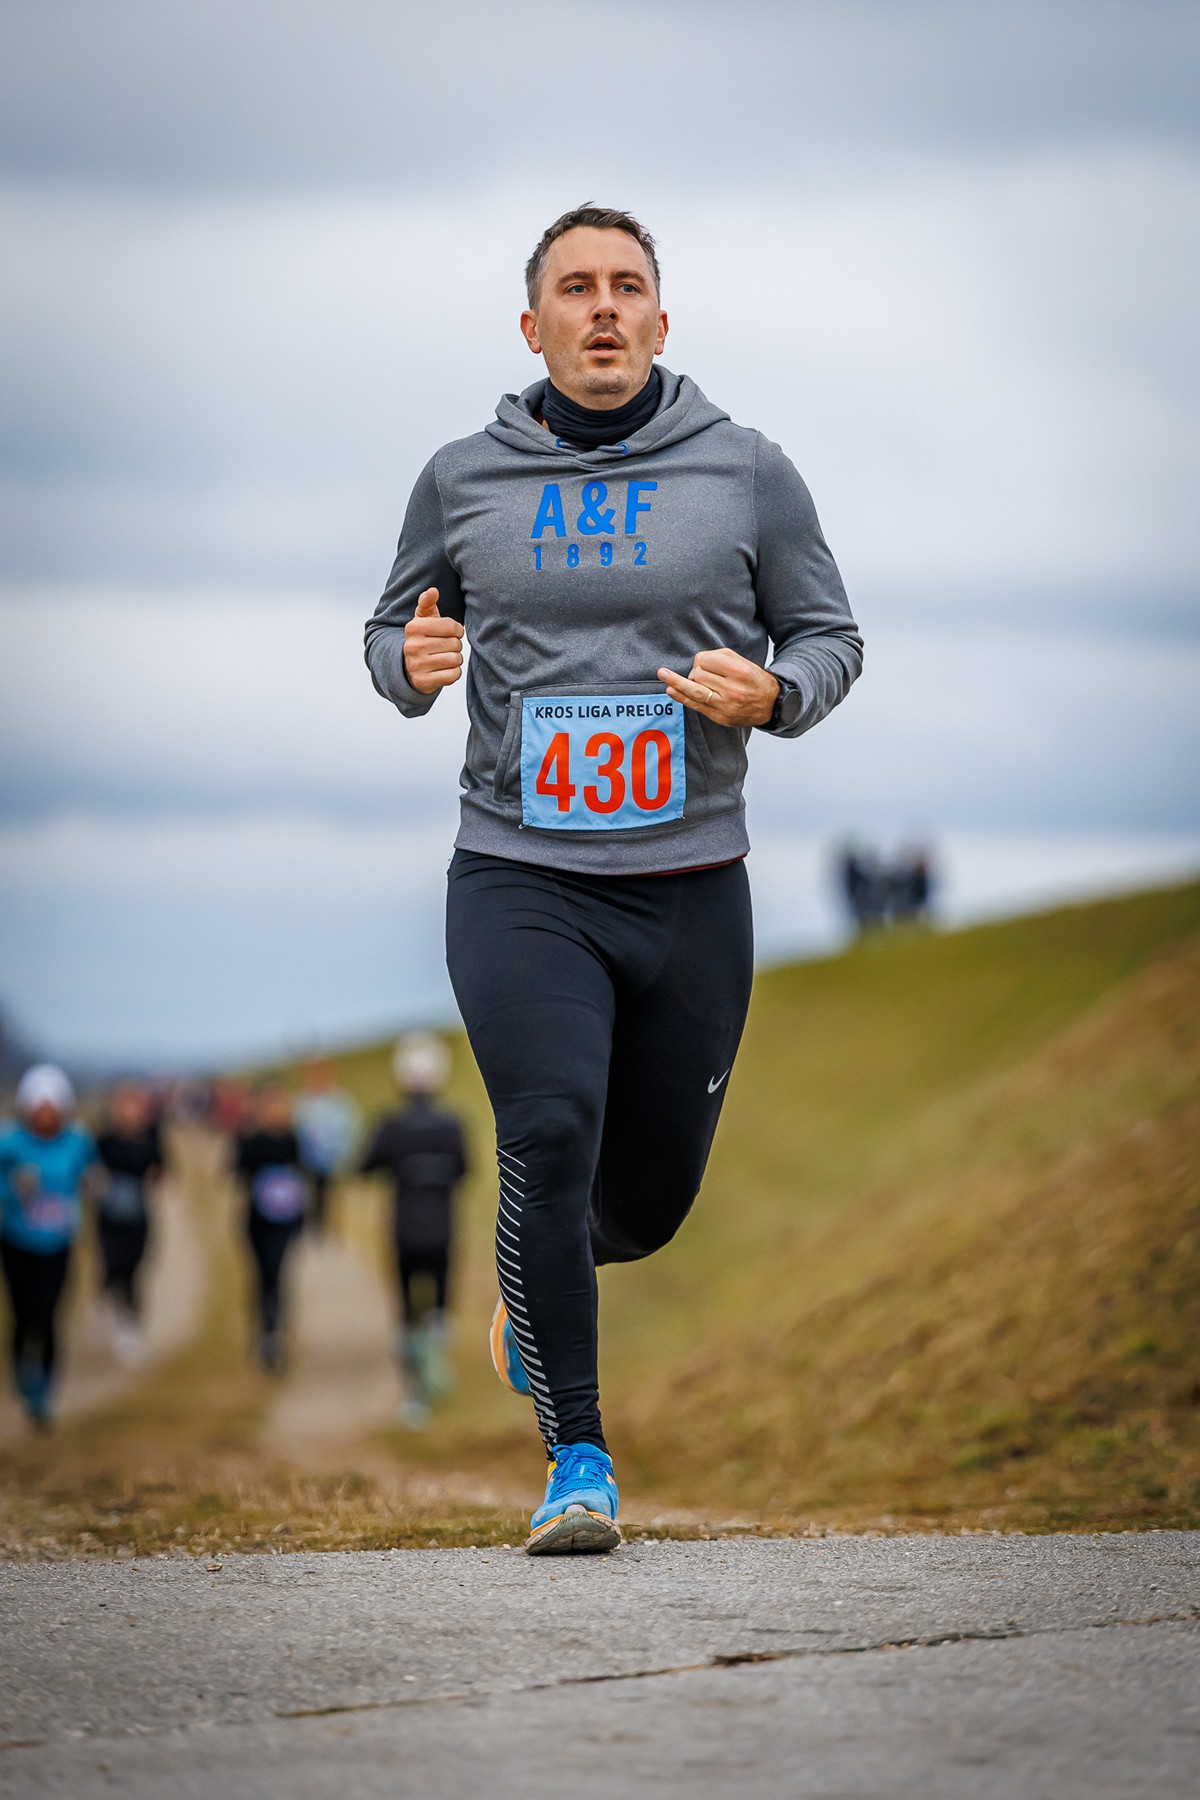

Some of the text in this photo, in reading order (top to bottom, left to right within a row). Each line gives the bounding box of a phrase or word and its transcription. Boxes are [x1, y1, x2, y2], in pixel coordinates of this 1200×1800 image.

[531, 480, 658, 538] A&F
[533, 541, 647, 570] 1892
[535, 703, 673, 719] KROS LIGA PRELOG
[535, 729, 672, 814] 430
